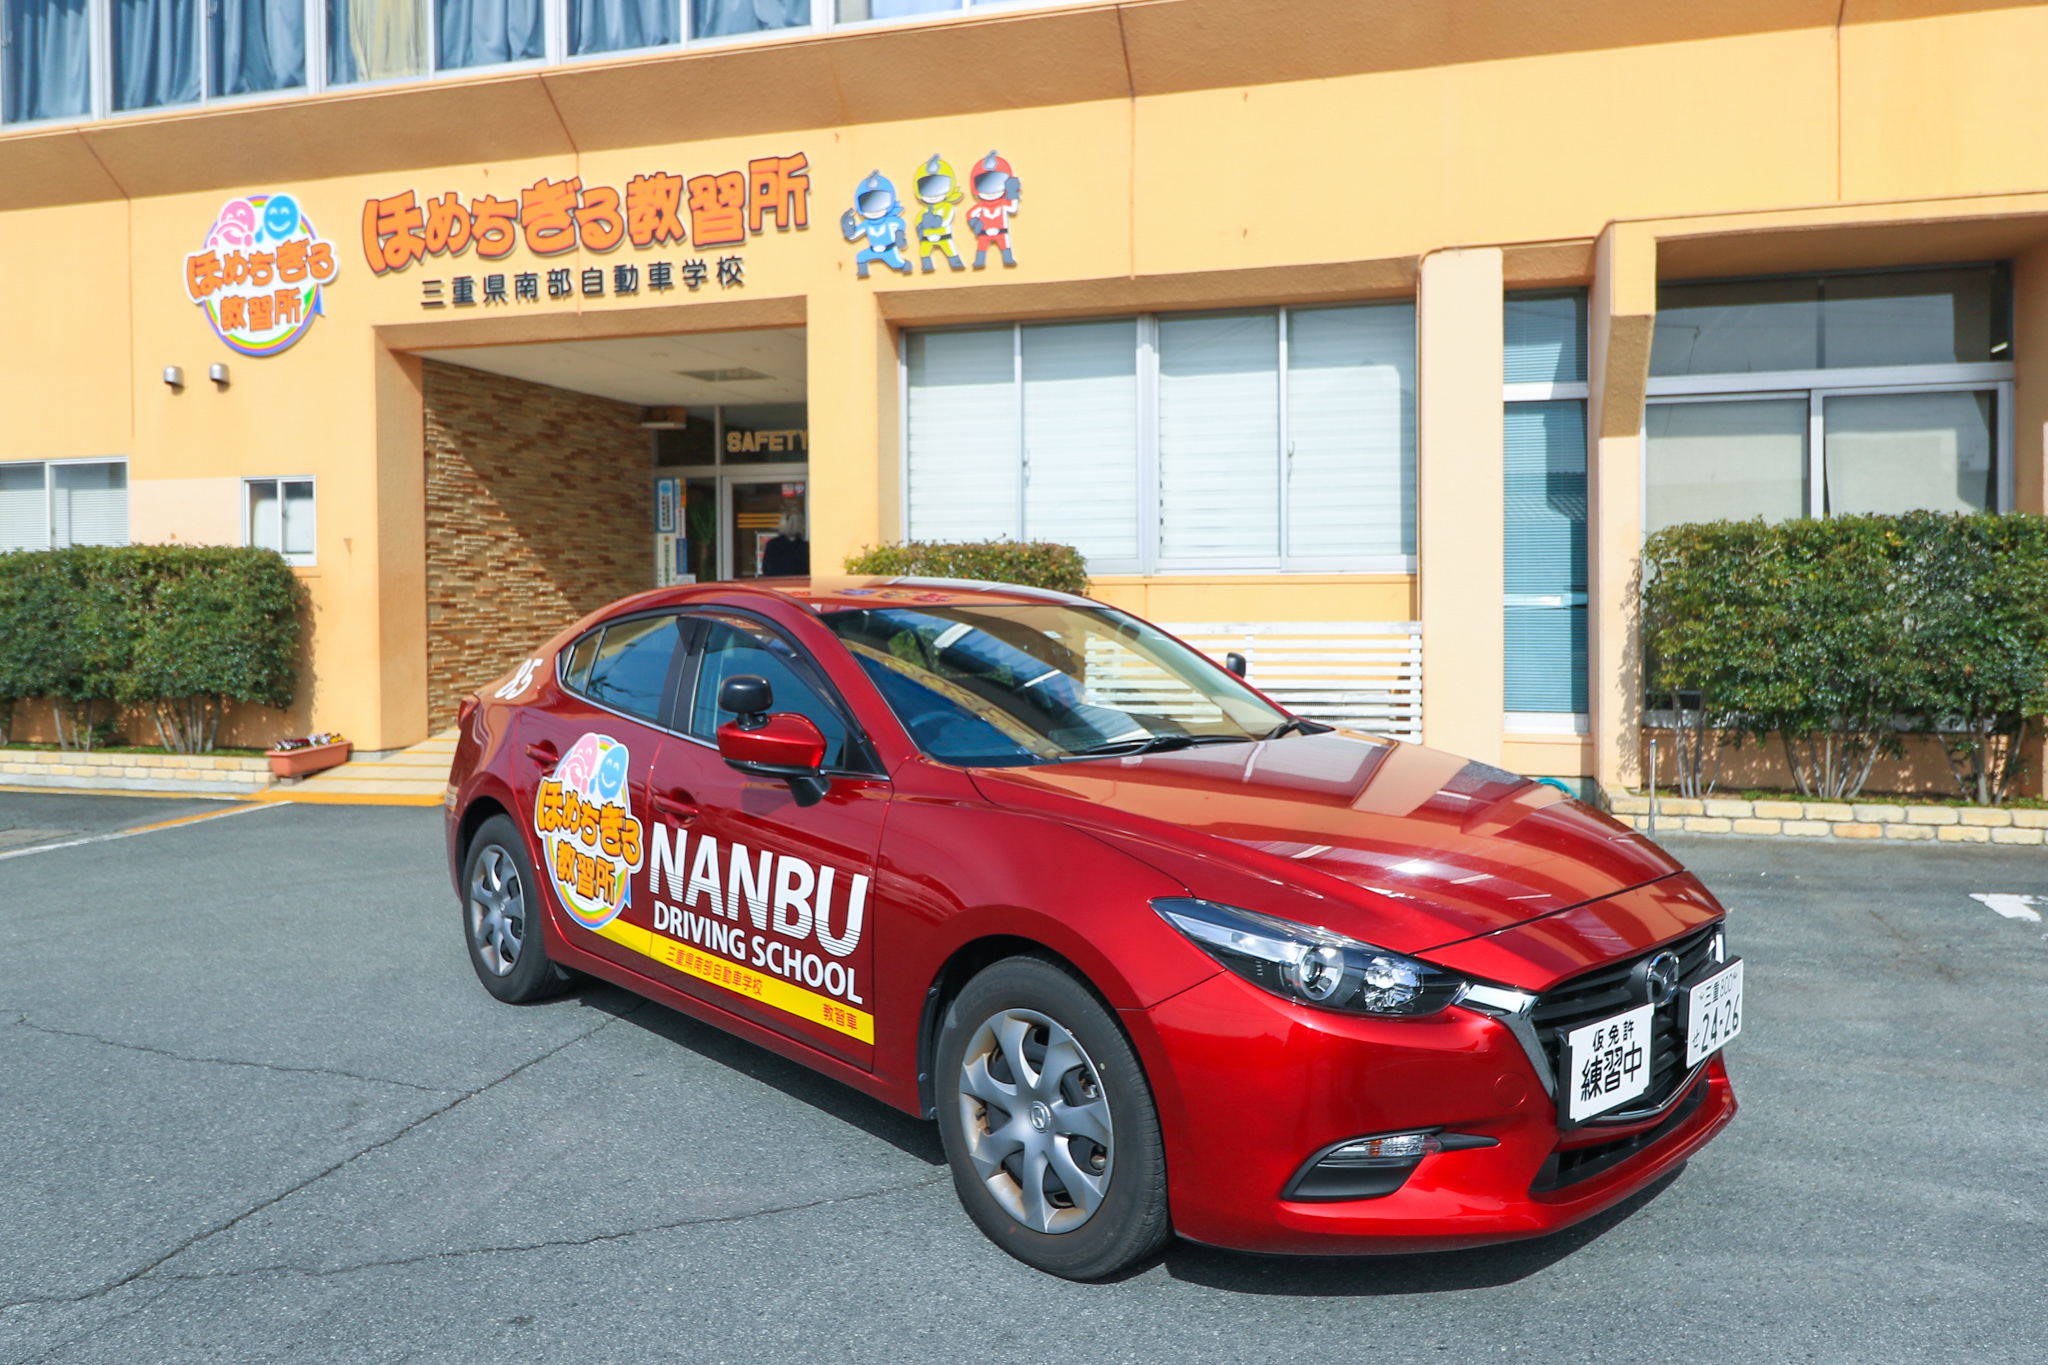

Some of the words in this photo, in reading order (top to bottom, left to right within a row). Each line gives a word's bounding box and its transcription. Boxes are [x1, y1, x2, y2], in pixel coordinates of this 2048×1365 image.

[362, 152, 810, 274] ほめちぎる教習所
[186, 238, 334, 299] ほめちぎる
[421, 256, 746, 307] 三重県南部自動車学校
[220, 287, 301, 332] 教習所
[536, 779, 641, 866] ほめちぎる
[556, 840, 616, 905] 教習所
[649, 822, 869, 957] NANBU
[653, 900, 746, 960] DRIVING
[751, 935, 863, 1005] SCHOOL
[666, 946, 763, 996] 三重県南部自動車学校
[823, 1003, 858, 1030] 教習車
[1592, 1019, 1634, 1052] 仮免許
[1580, 1041, 1642, 1102] 練習中
